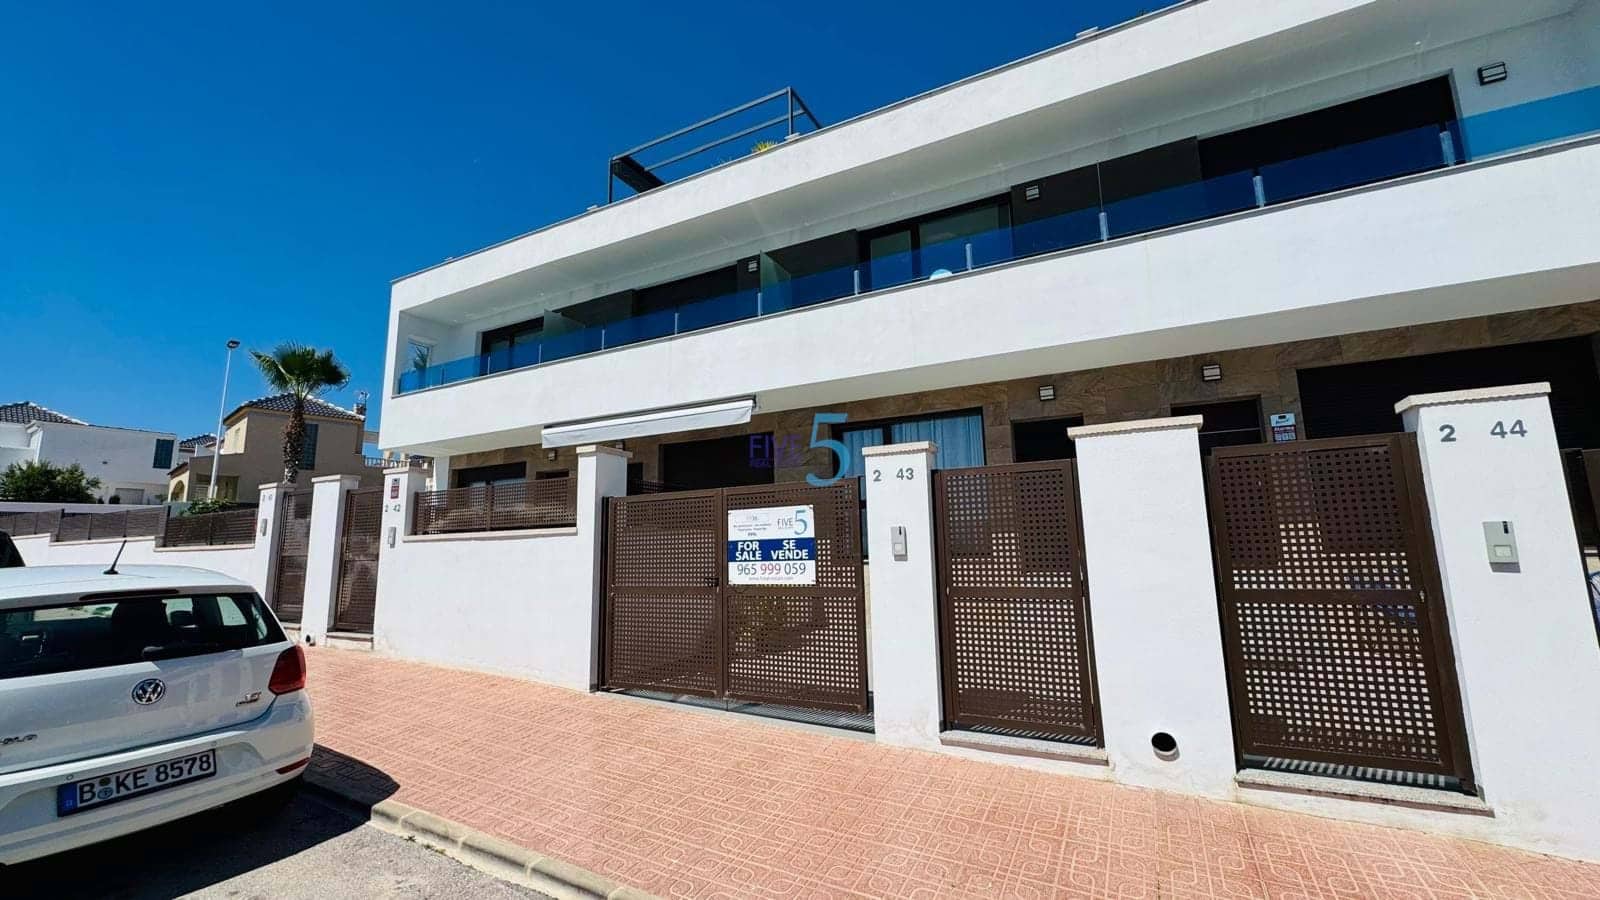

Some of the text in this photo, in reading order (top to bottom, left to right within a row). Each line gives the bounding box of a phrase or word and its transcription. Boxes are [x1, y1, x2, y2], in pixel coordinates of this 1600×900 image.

[1439, 419, 1528, 442] 2 44
[873, 467, 914, 482] 2 43
[777, 510, 808, 536] FIVE 5
[737, 541, 760, 551] FOR
[782, 540, 797, 550] SE
[735, 551, 762, 561] SALE
[770, 549, 809, 560] VENDE
[736, 562, 806, 576] 965 999 059
[78, 753, 212, 804] B KE 8578
